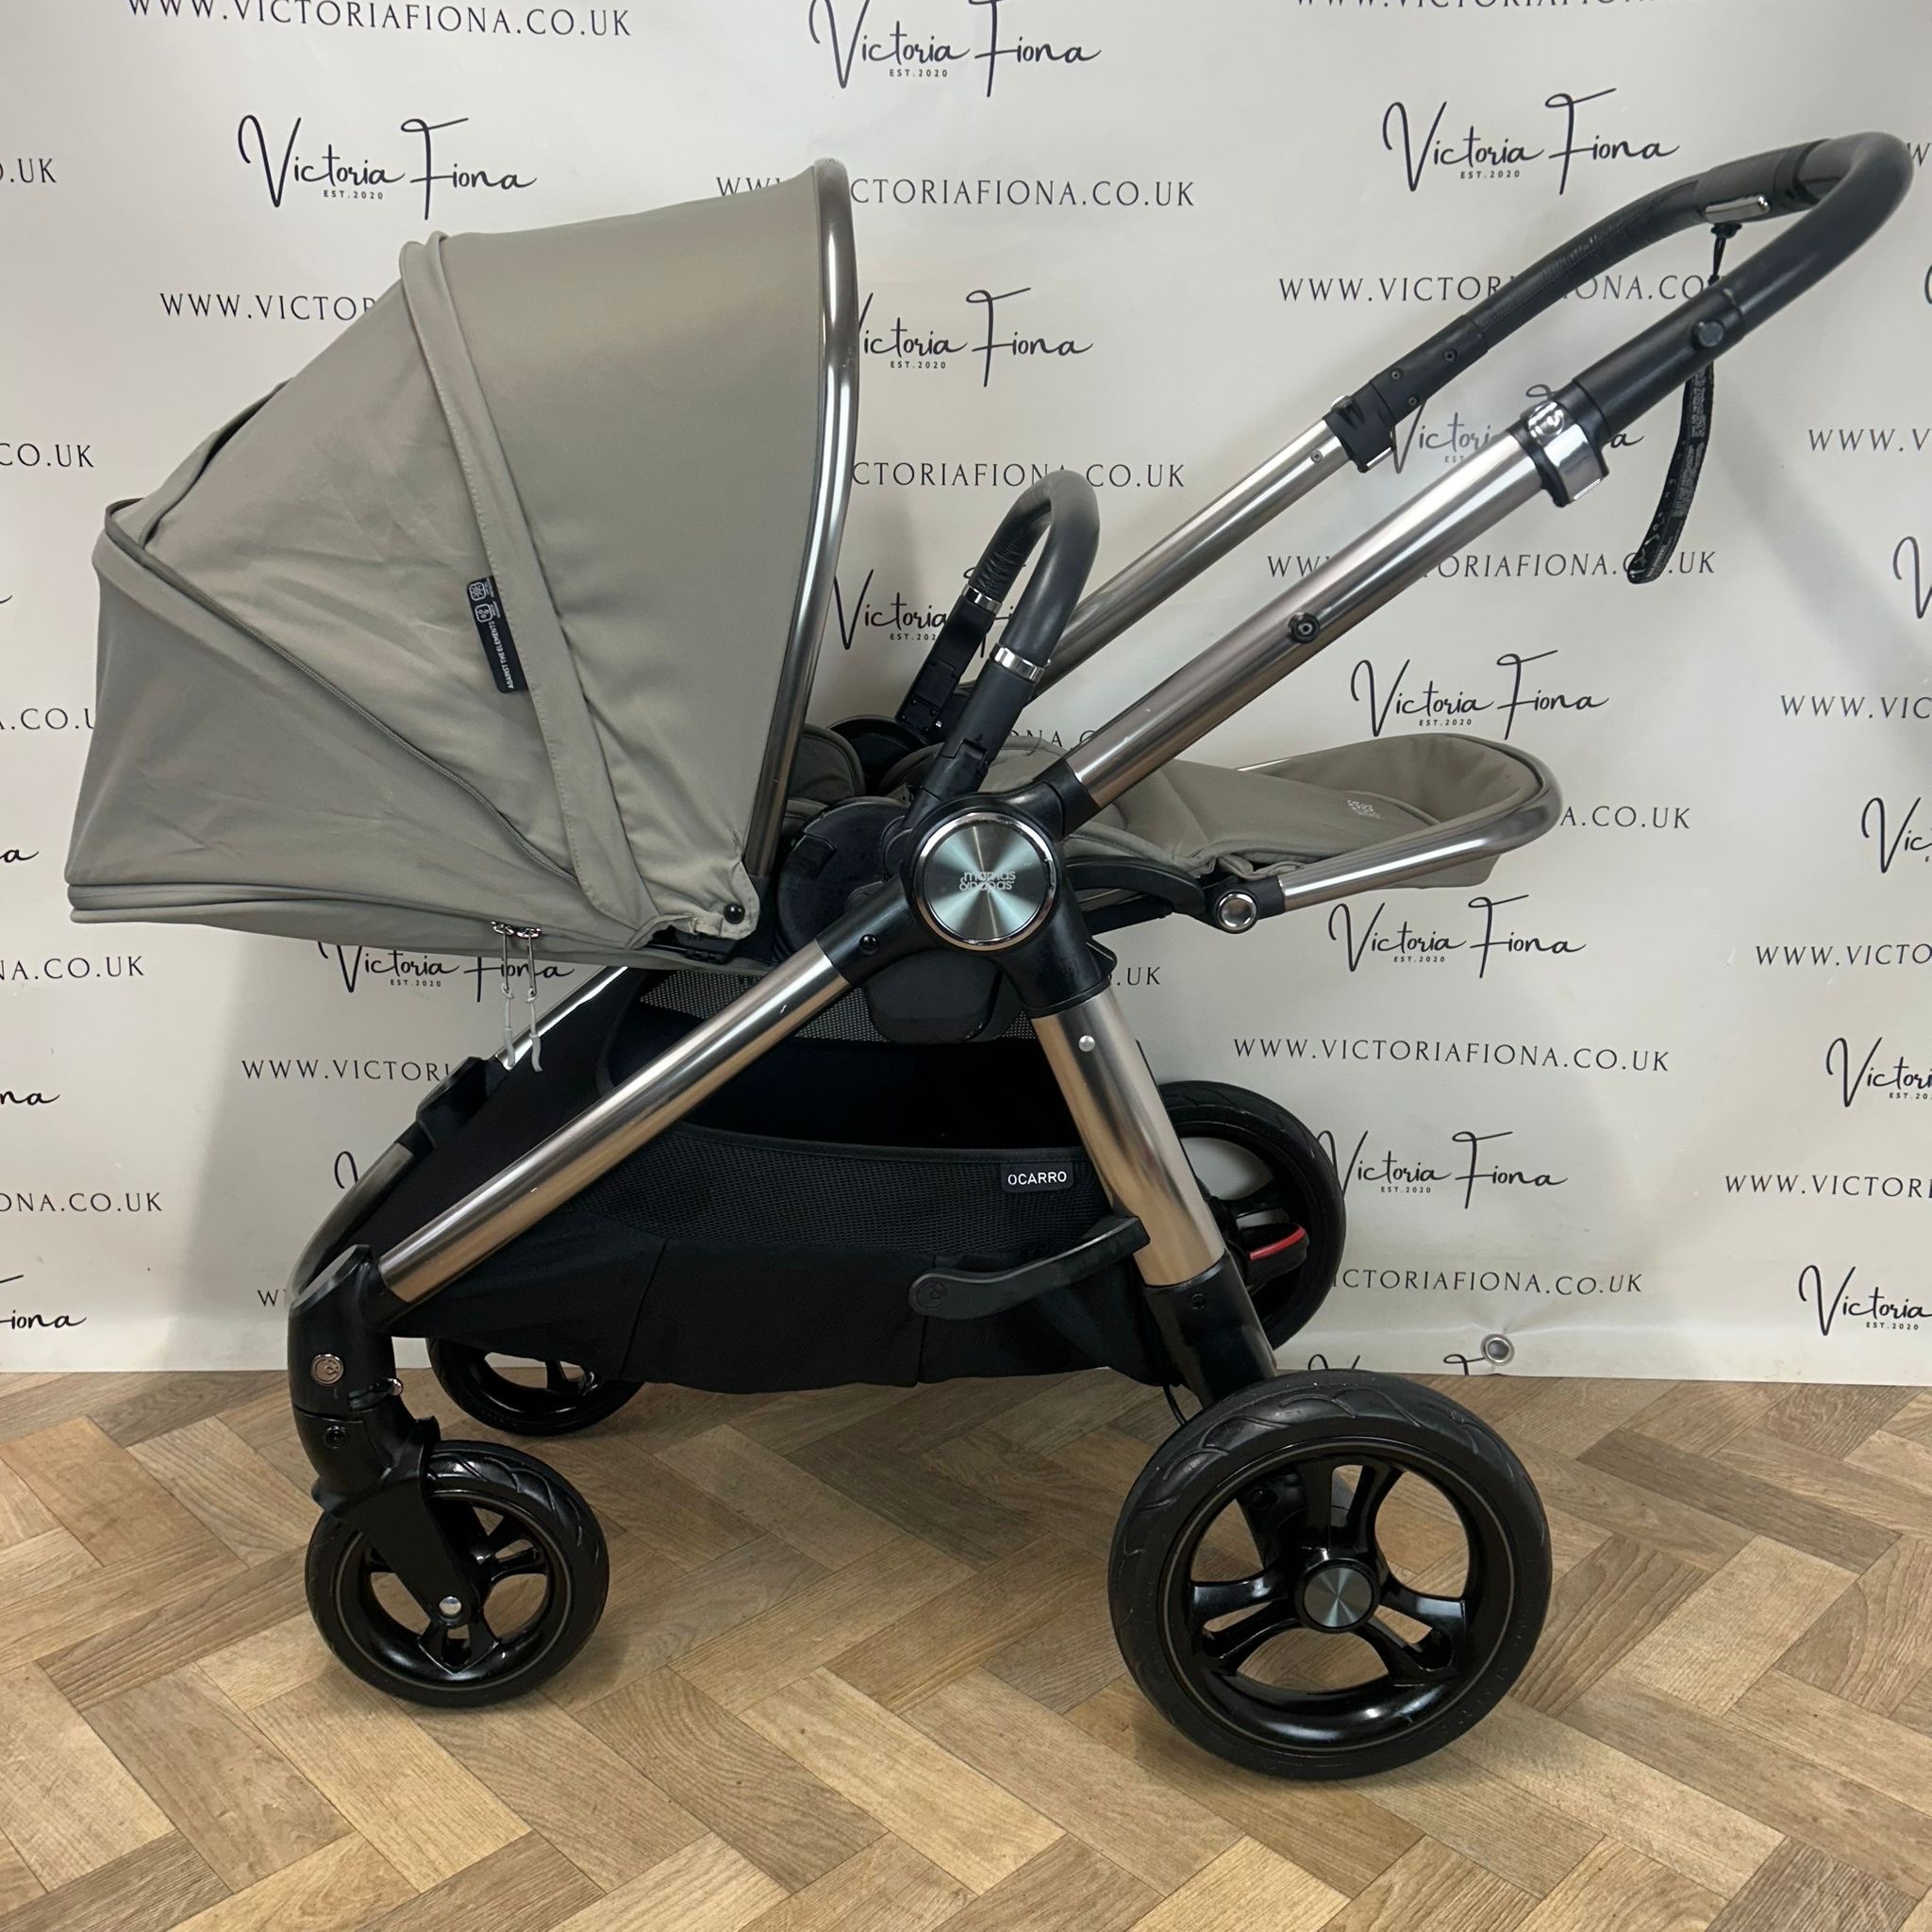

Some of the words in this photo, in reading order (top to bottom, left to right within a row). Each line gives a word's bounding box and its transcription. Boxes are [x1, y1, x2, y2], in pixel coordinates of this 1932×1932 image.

[808, 0, 971, 89] Victoria
[969, 0, 1101, 97] Fiona
[890, 69, 948, 77] EST.2020
[238, 114, 406, 208] Victoria
[401, 118, 537, 220] Fiona
[1382, 101, 1545, 192] Victoria
[1545, 88, 1680, 195] Fiona
[1460, 170, 1520, 179] EST.2020
[324, 190, 384, 199] EST.2020
[891, 360, 946, 369] EST.2020
[966, 287, 1093, 387] Fiona
[1350, 658, 1494, 738] Victoria
[1496, 650, 1609, 740] Fiona
[1328, 903, 1467, 973] Victoria
[1468, 894, 1587, 978] Fiona
[1233, 1039, 1670, 1073] WWW.VICTORIAFIONA.CO.UK
[1008, 1171, 1067, 1186] OCARRO
[1452, 1131, 1568, 1209] Fiona
[1799, 1265, 1932, 1336] Victoria
